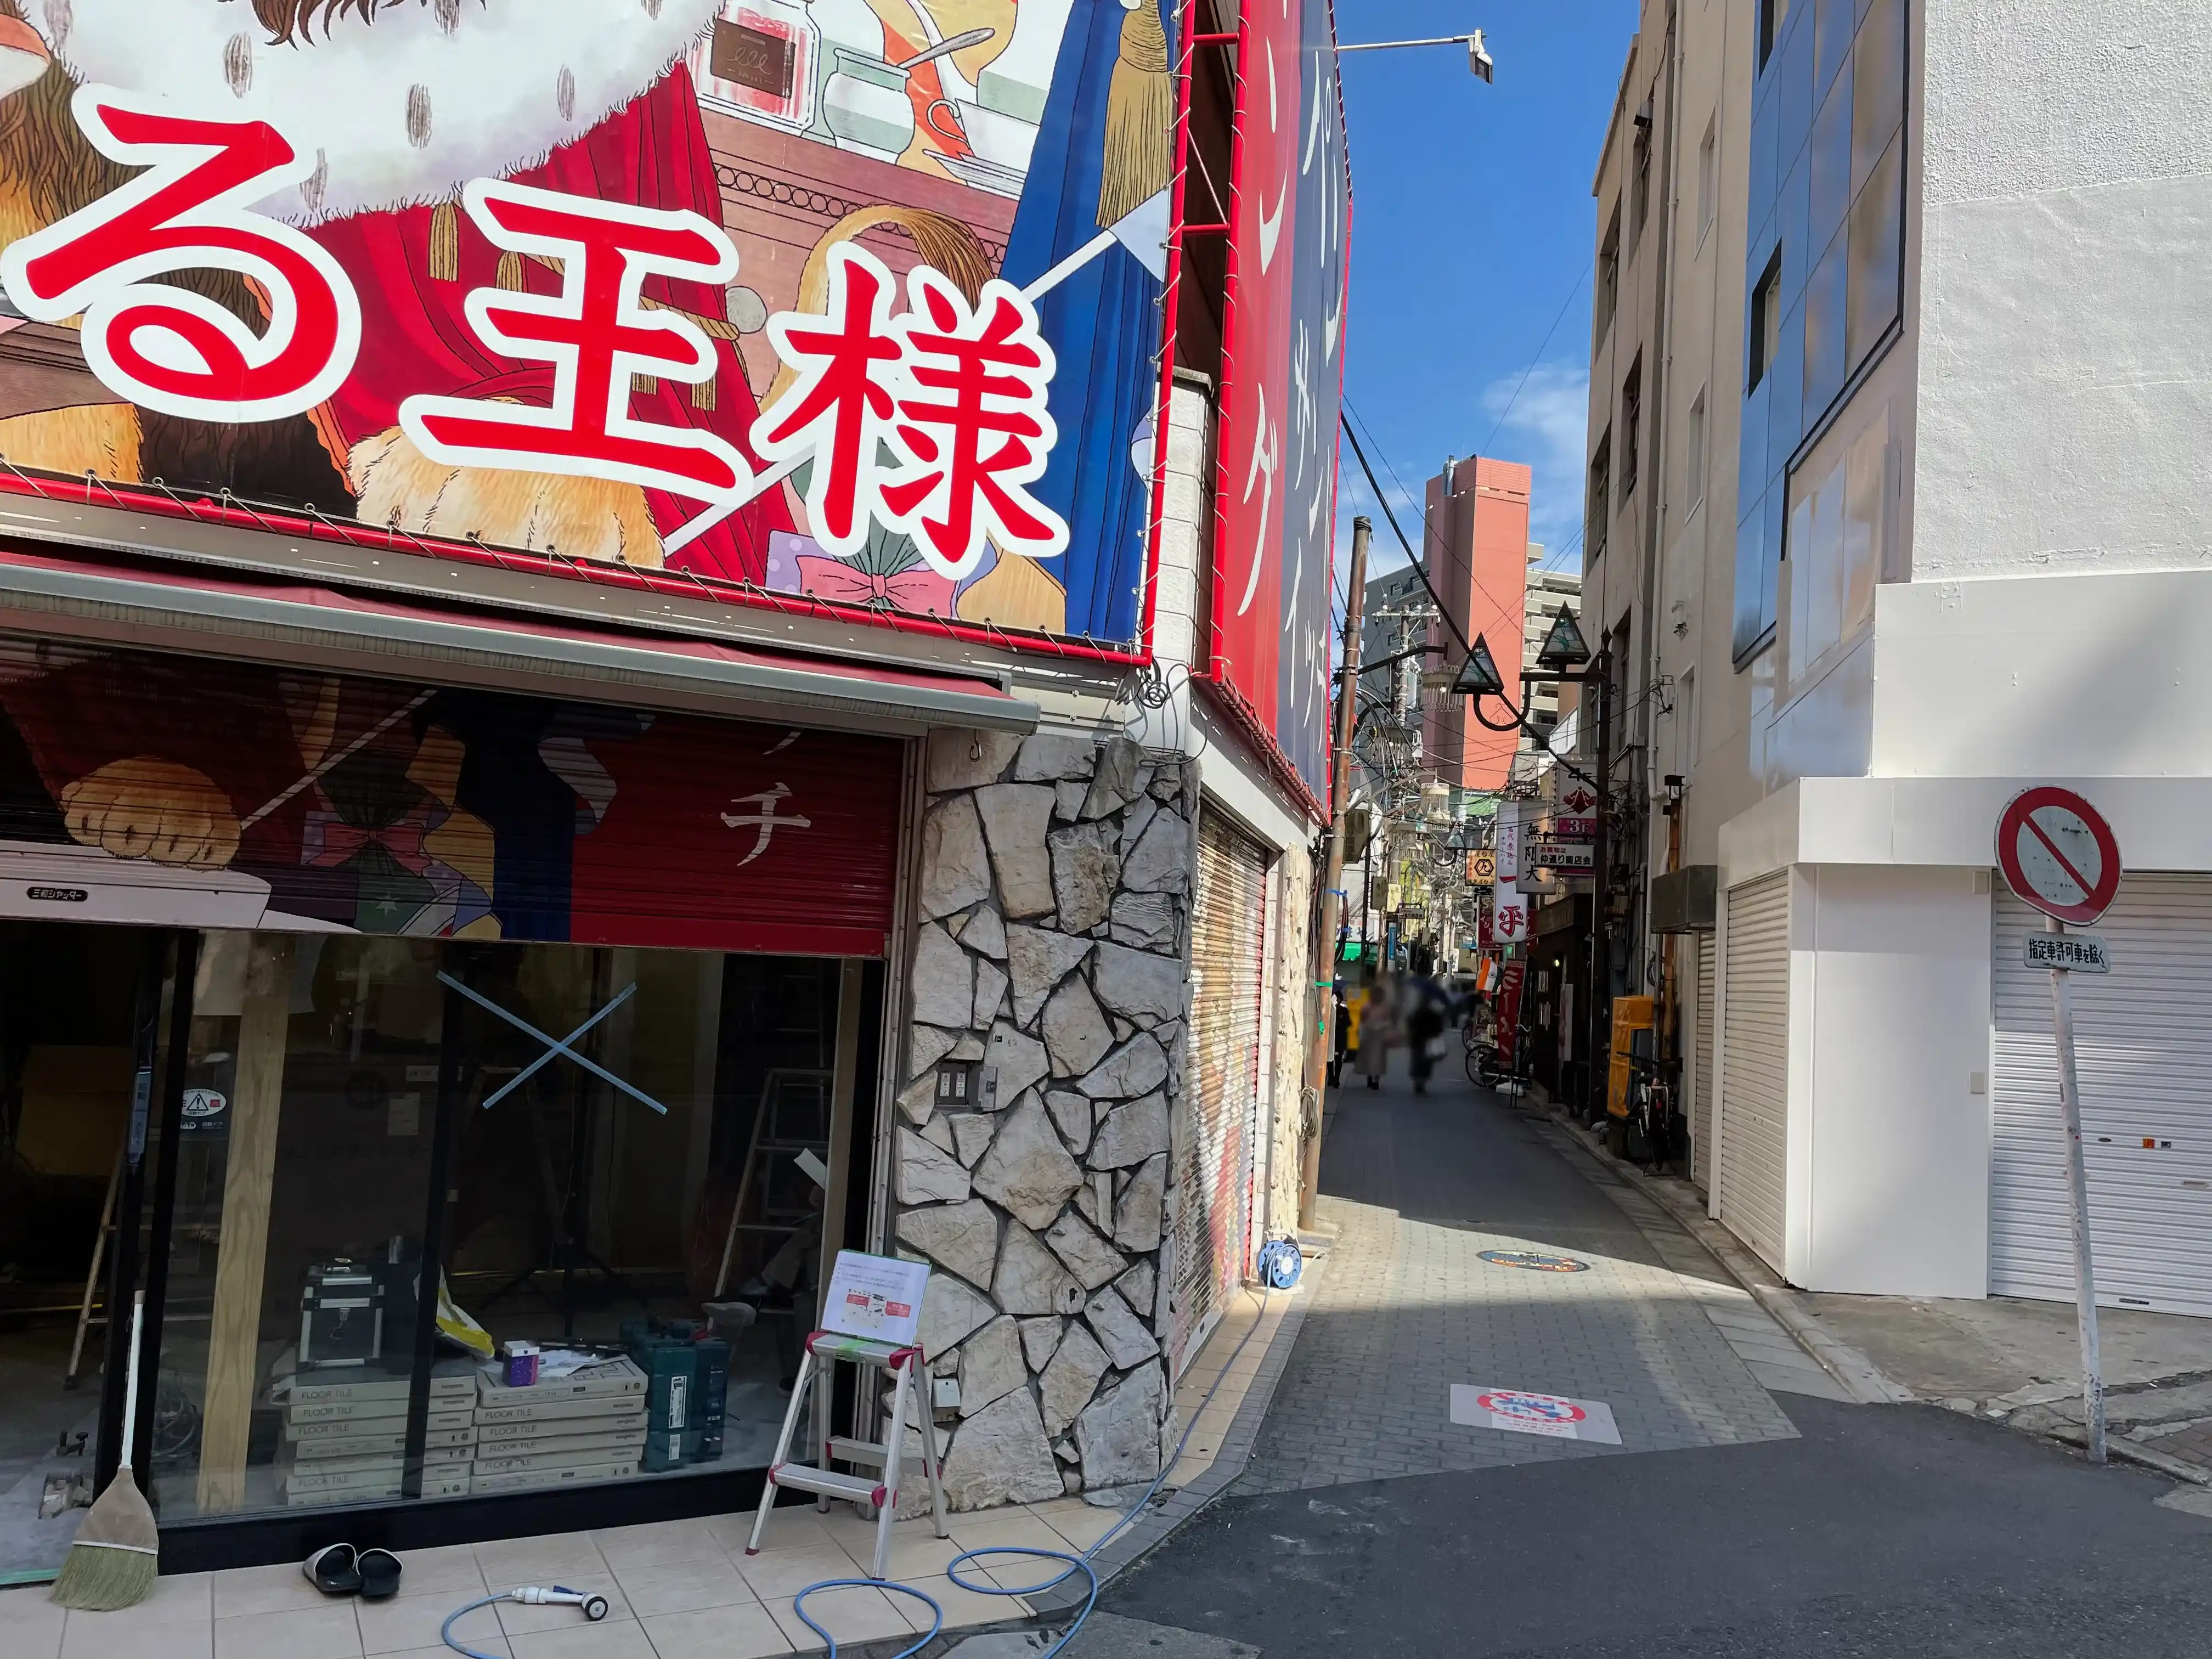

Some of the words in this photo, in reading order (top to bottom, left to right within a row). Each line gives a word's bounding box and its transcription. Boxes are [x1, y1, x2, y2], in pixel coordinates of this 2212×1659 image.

[1302, 50, 1343, 367] パン
[1238, 0, 1288, 616] ング
[1, 82, 1069, 577] る王様
[1569, 820, 1590, 832] 3F
[1524, 823, 1542, 882] 無限大
[1541, 854, 1591, 865] 仲通り商店会
[1498, 876, 1524, 937] 一平
[2029, 938, 2105, 965] 指定車許可車を除く
[302, 1390, 331, 1399] FLOOR
[303, 1407, 333, 1417] FLOOR
[337, 1406, 354, 1414] TILE
[485, 1410, 513, 1419] FLOOR
[298, 1425, 329, 1435] FLOOR
[332, 1424, 349, 1432] TILE
[490, 1427, 517, 1435] FLOOR
[489, 1443, 517, 1452] FLOOR
